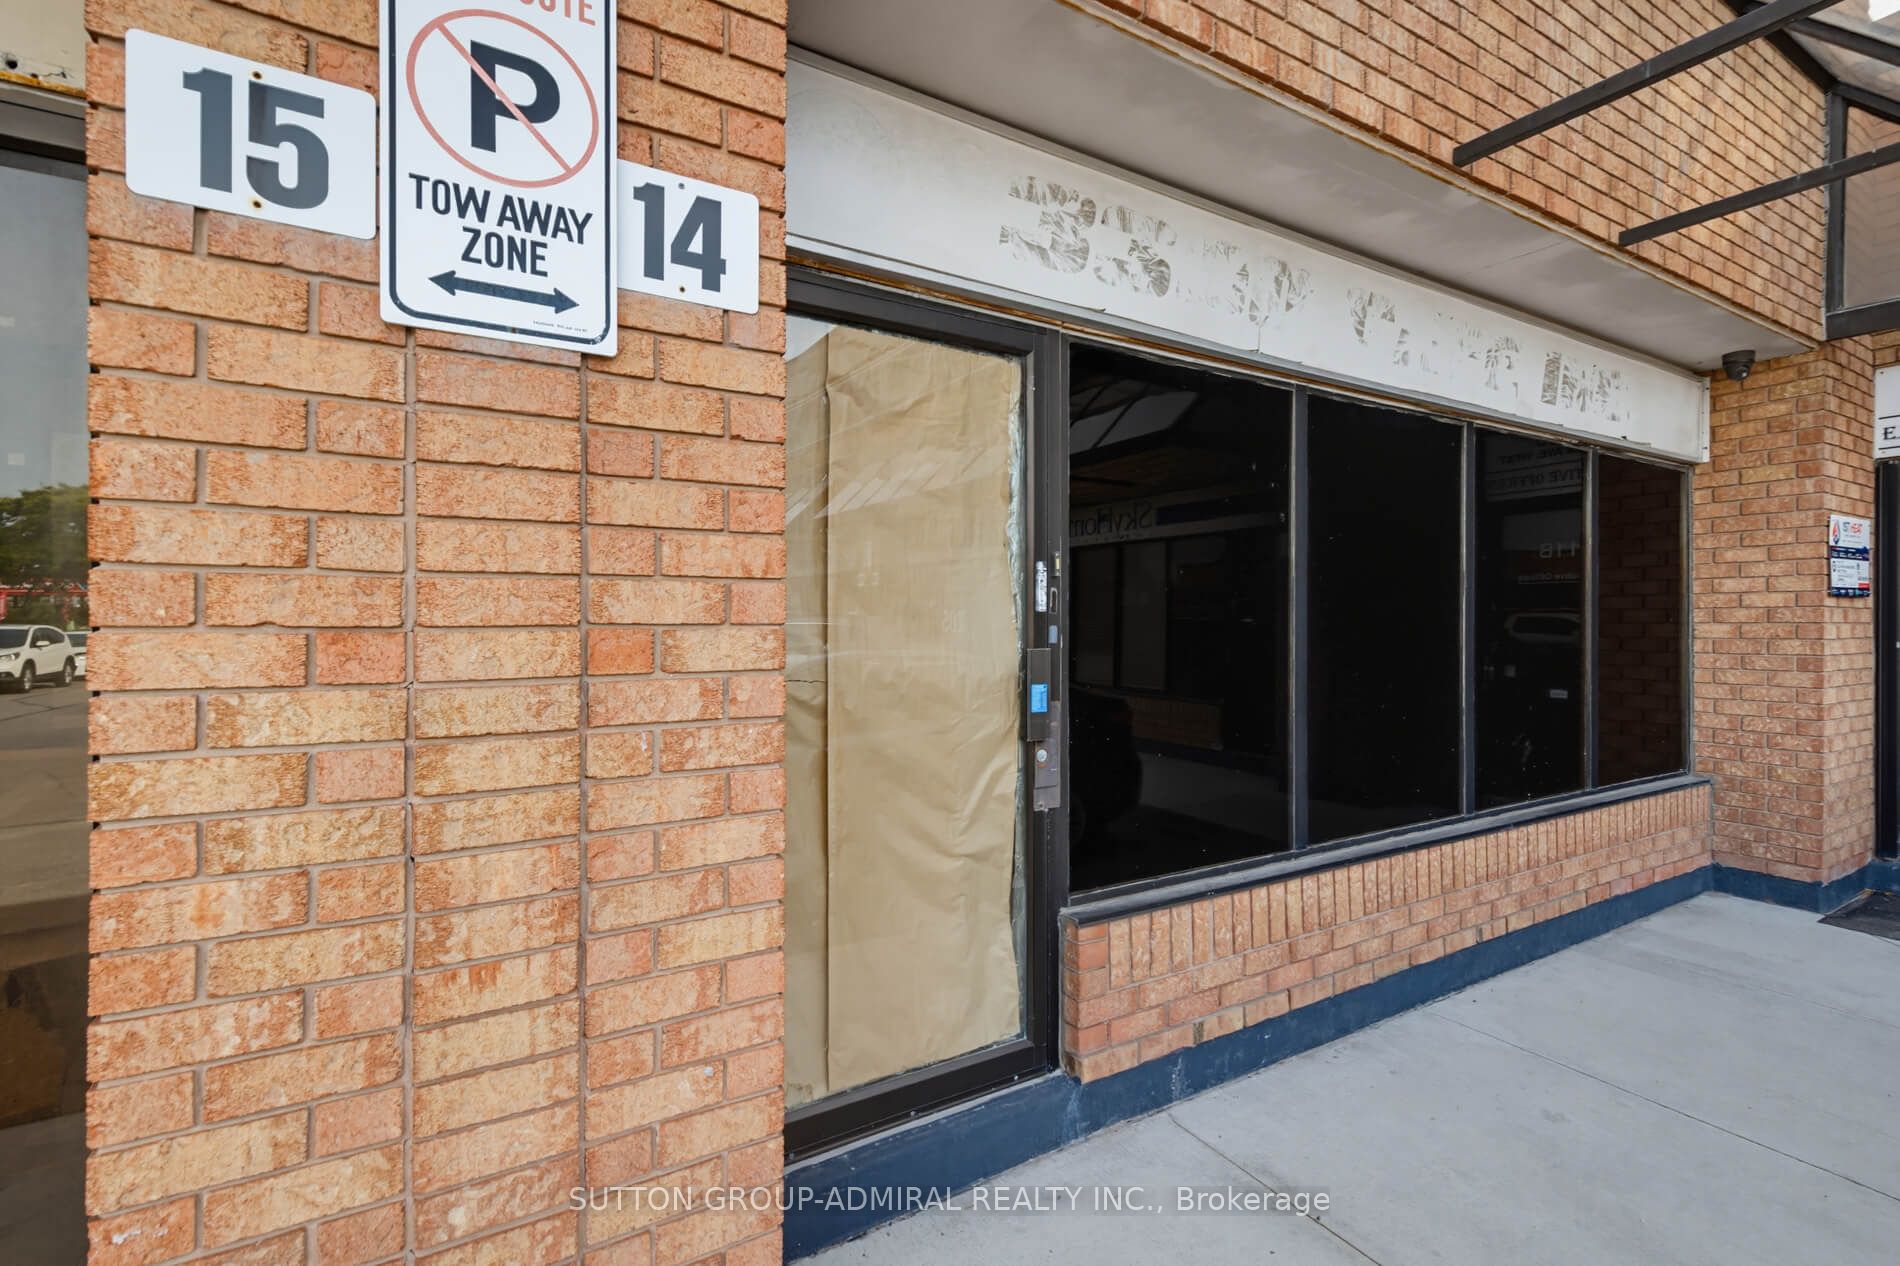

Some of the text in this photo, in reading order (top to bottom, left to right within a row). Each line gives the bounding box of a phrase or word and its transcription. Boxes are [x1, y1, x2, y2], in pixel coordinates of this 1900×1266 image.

[182, 67, 330, 210] 15
[408, 172, 593, 245] TOW AWAY
[461, 225, 549, 278] ZONE
[633, 181, 727, 293] 14
